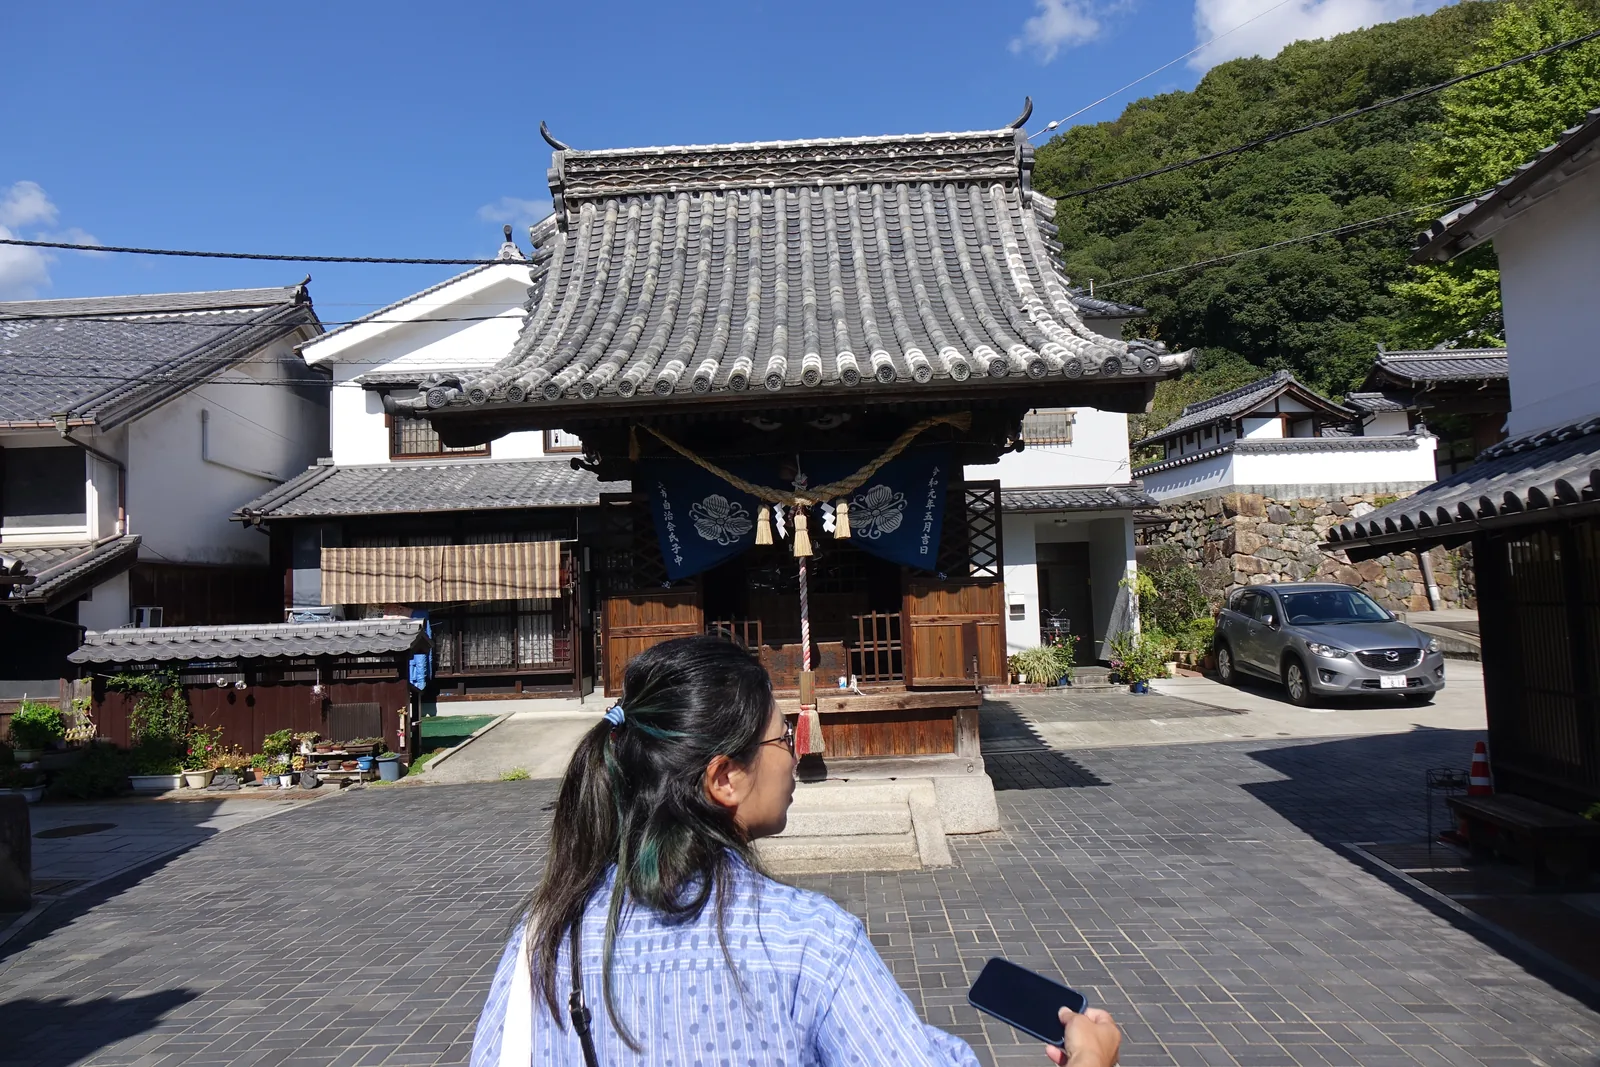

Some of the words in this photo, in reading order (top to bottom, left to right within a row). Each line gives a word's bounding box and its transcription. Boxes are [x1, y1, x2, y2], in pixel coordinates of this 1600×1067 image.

[919, 466, 940, 555] 令和元年五月吉日
